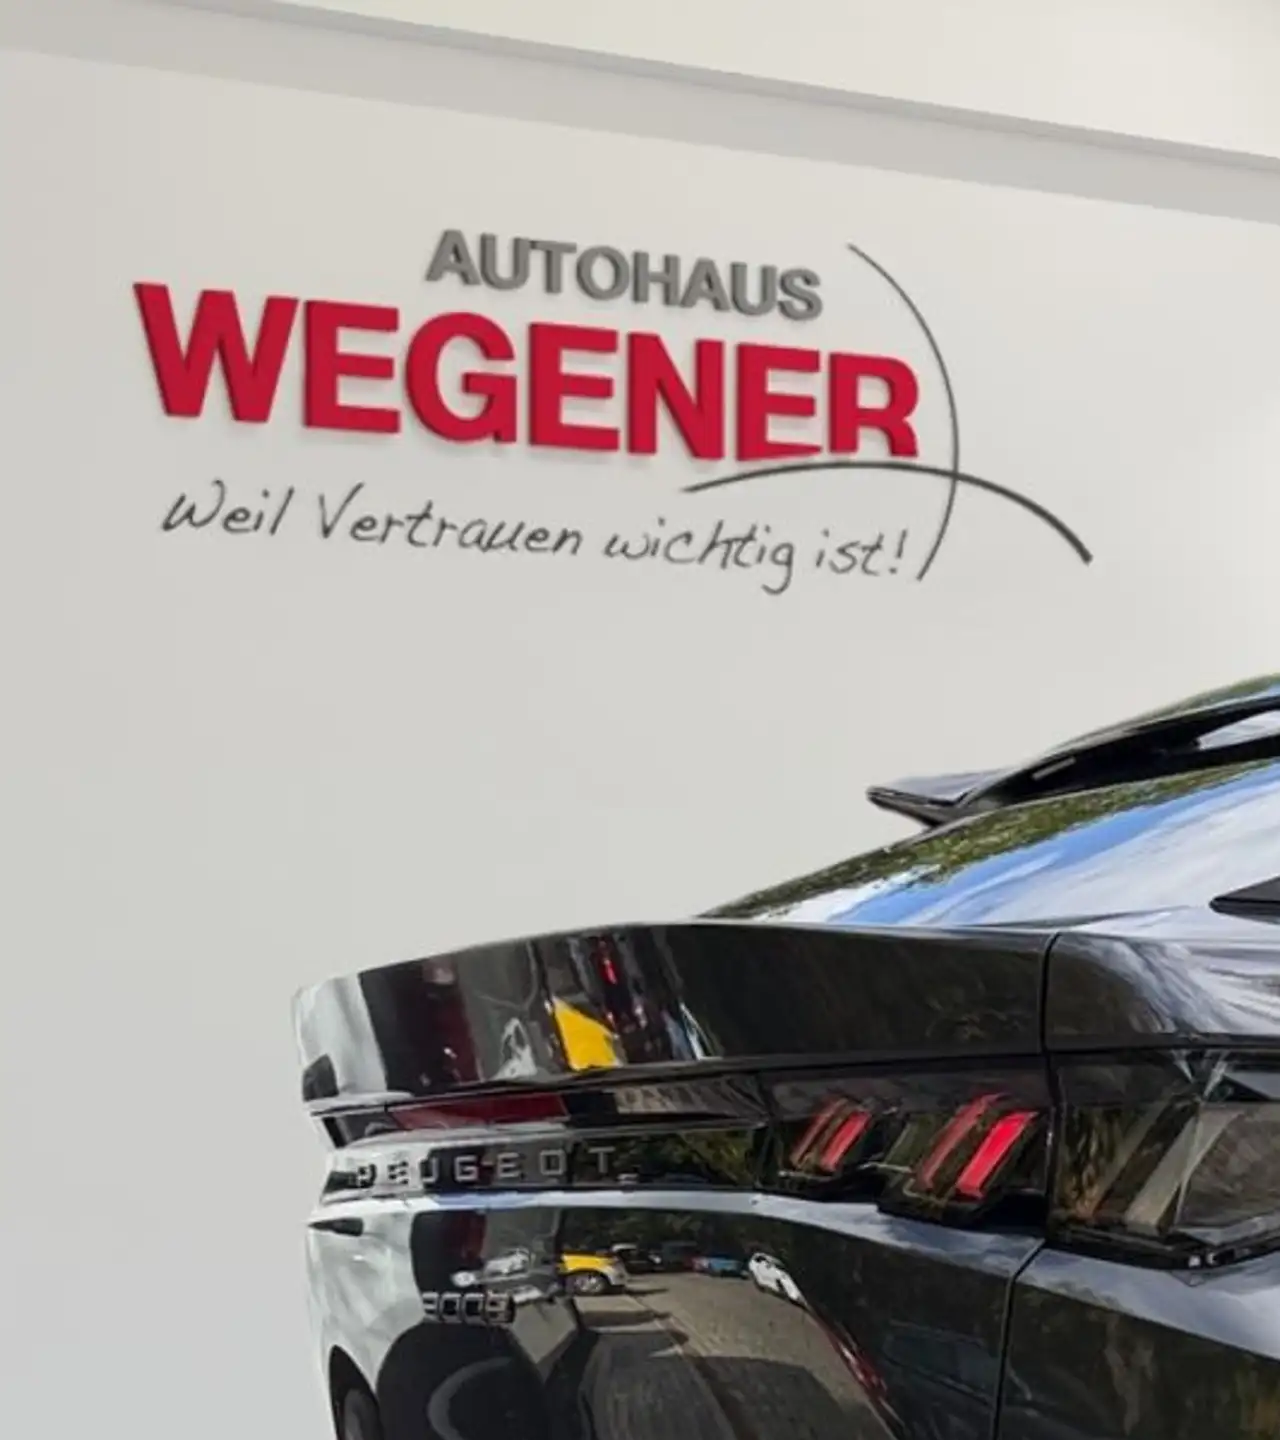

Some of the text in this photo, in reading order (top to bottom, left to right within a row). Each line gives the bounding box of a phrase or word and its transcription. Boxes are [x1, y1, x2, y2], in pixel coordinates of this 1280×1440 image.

[426, 230, 823, 321] AUTOHAUS
[133, 281, 920, 463] WEGENER
[162, 478, 908, 596] Weil Vertrauen wichtig ist!
[355, 1145, 617, 1188] PEUGEOT
